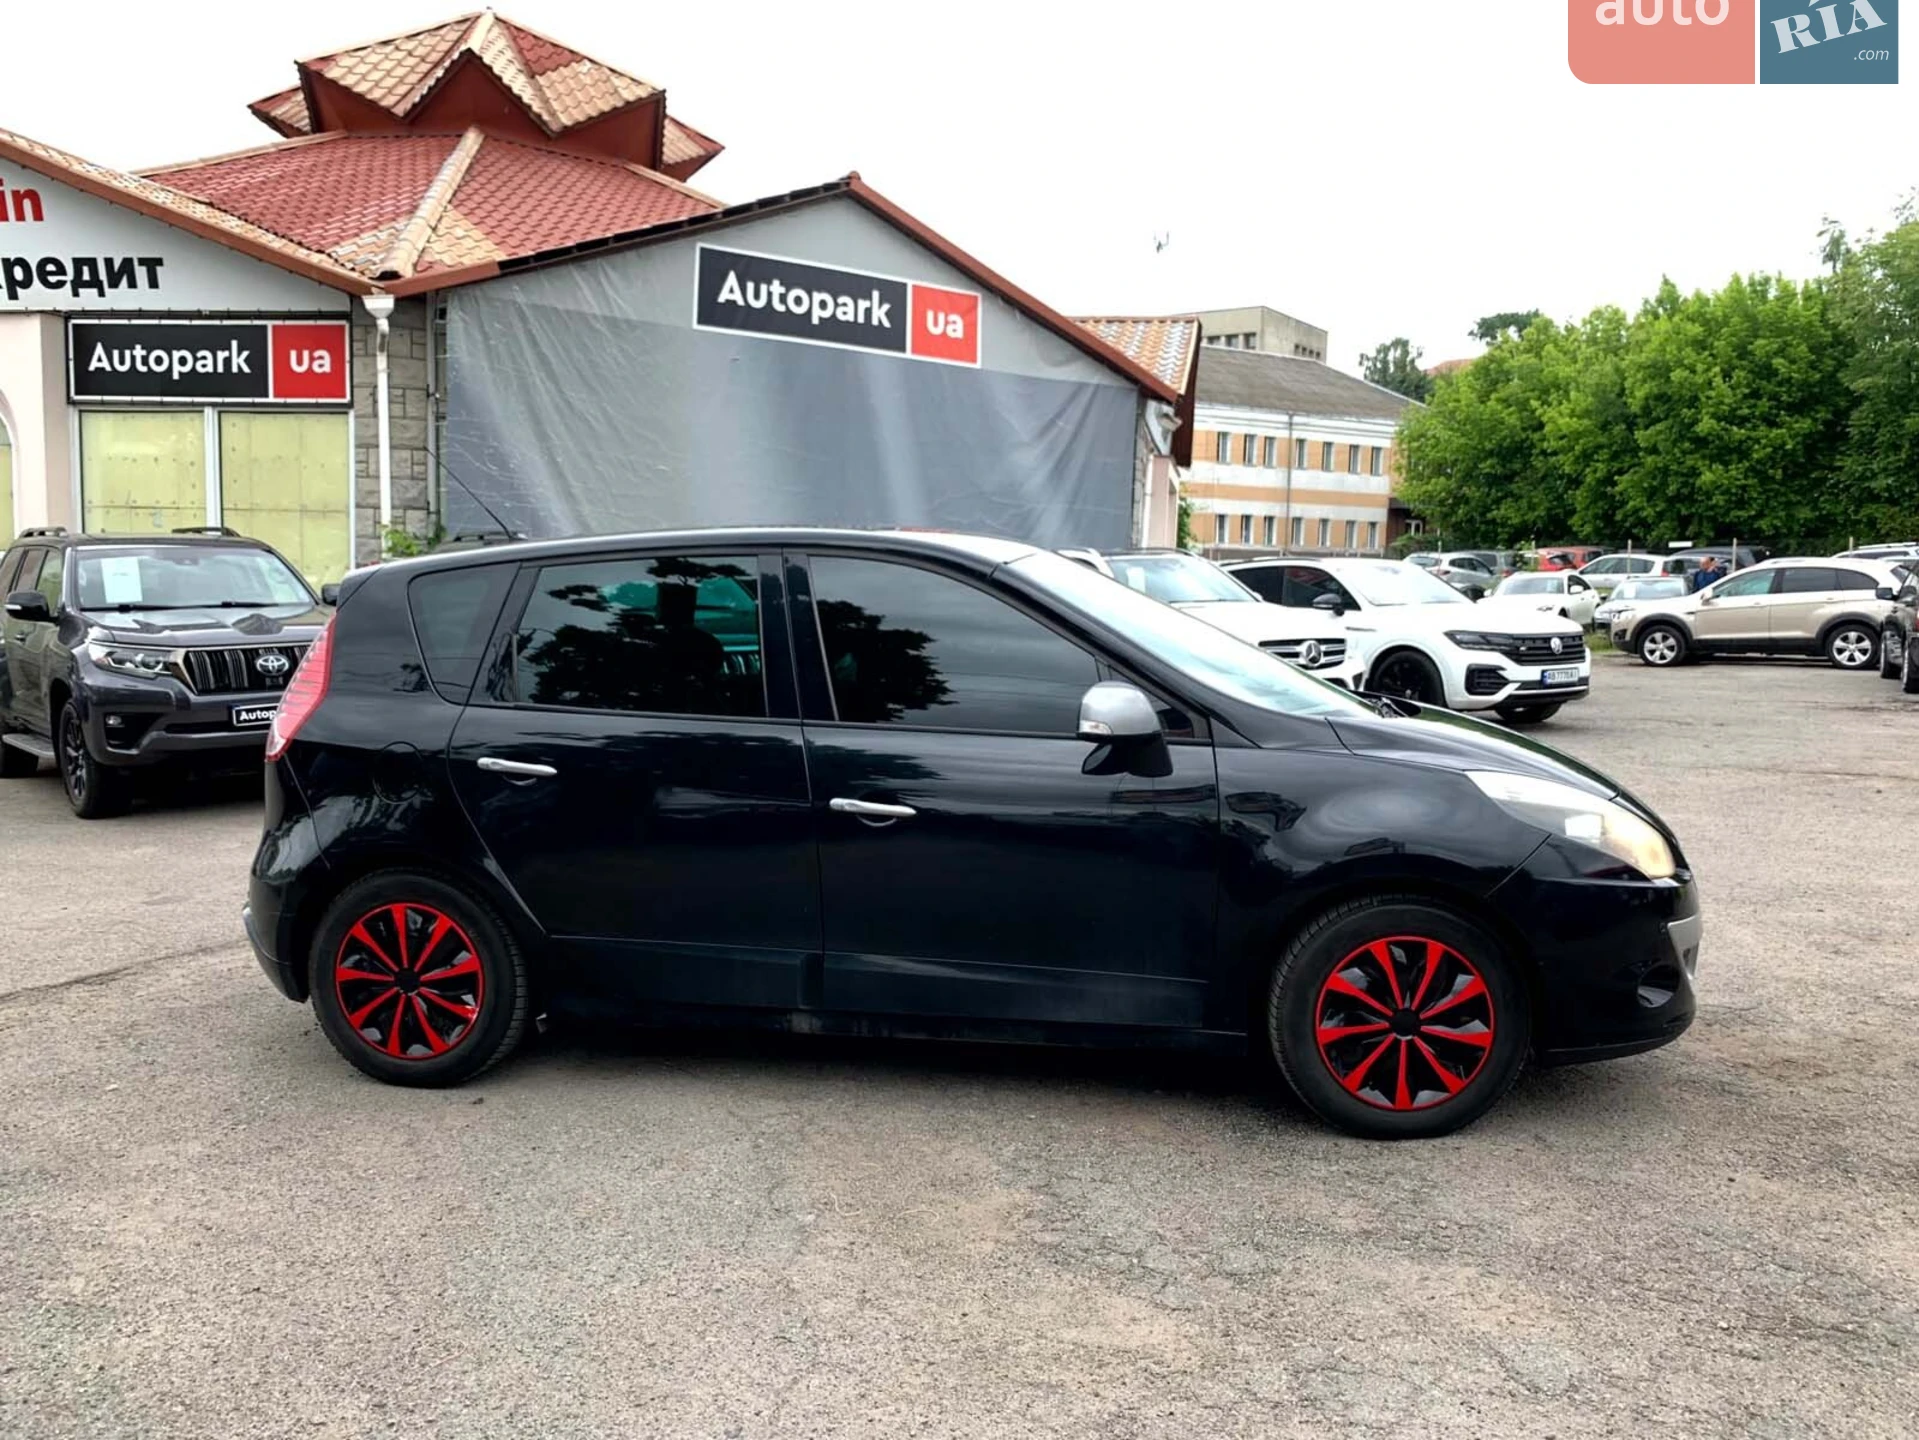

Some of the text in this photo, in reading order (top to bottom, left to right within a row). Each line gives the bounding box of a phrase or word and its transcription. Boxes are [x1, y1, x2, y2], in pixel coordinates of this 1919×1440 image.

[0, 256, 164, 300] редит
[717, 269, 964, 339] Autopark ua
[88, 340, 331, 380] Autopark ua
